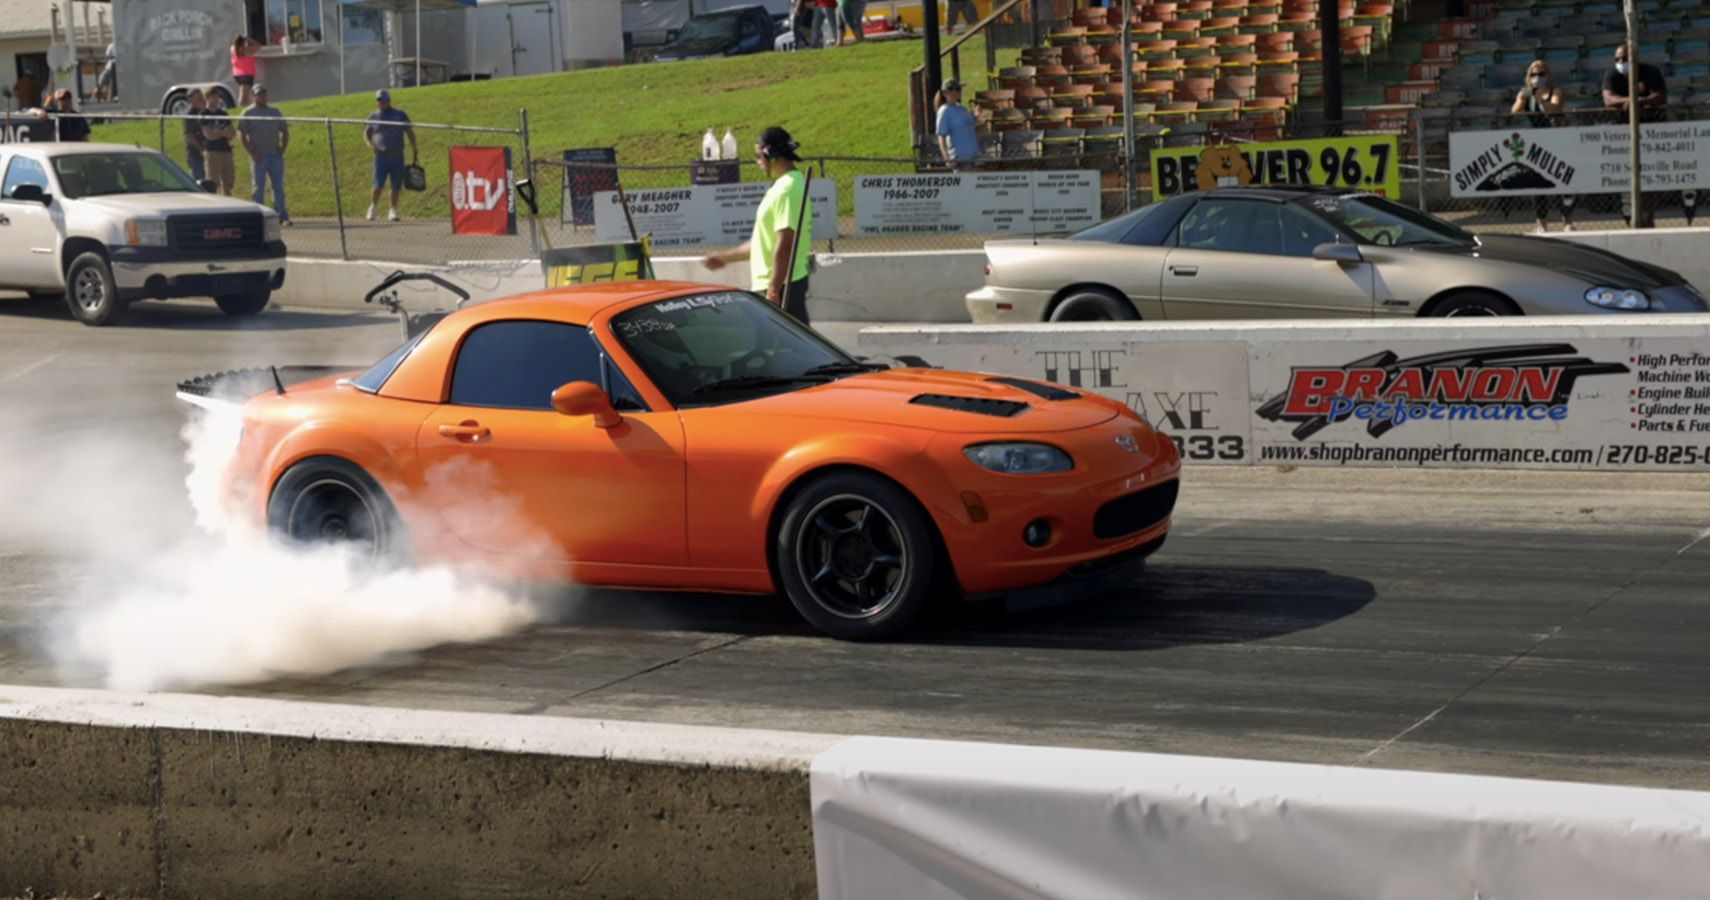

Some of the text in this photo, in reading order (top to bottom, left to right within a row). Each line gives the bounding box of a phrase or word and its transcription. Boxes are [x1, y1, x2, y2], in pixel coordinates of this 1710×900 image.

[1645, 128, 1690, 140] Memorial
[1640, 142, 1695, 153] 70-842-4011
[1320, 144, 1391, 187] 96.7
[1455, 144, 1502, 190] SIMPLY
[1527, 142, 1575, 186] MULCH
[1673, 160, 1697, 171] Road
[862, 177, 961, 188] CHRIS THOMERSON
[1640, 174, 1696, 185] 70-793-1475
[641, 190, 692, 203] MEAGHER
[884, 189, 940, 200] 1966-2007
[629, 203, 680, 215] 948-2007
[204, 228, 242, 240] GMC
[1637, 354, 1667, 369] High
[1035, 350, 1127, 388] THE
[1637, 370, 1691, 383] Machine
[1281, 366, 1566, 416] BRANON
[1638, 386, 1681, 402] Engine
[1327, 396, 1569, 425] Performance
[1638, 403, 1691, 418] Cylinder
[1638, 420, 1673, 432] Parts
[1676, 419, 1686, 432] &
[1262, 443, 1592, 464] www.shopbranonperformance.com
